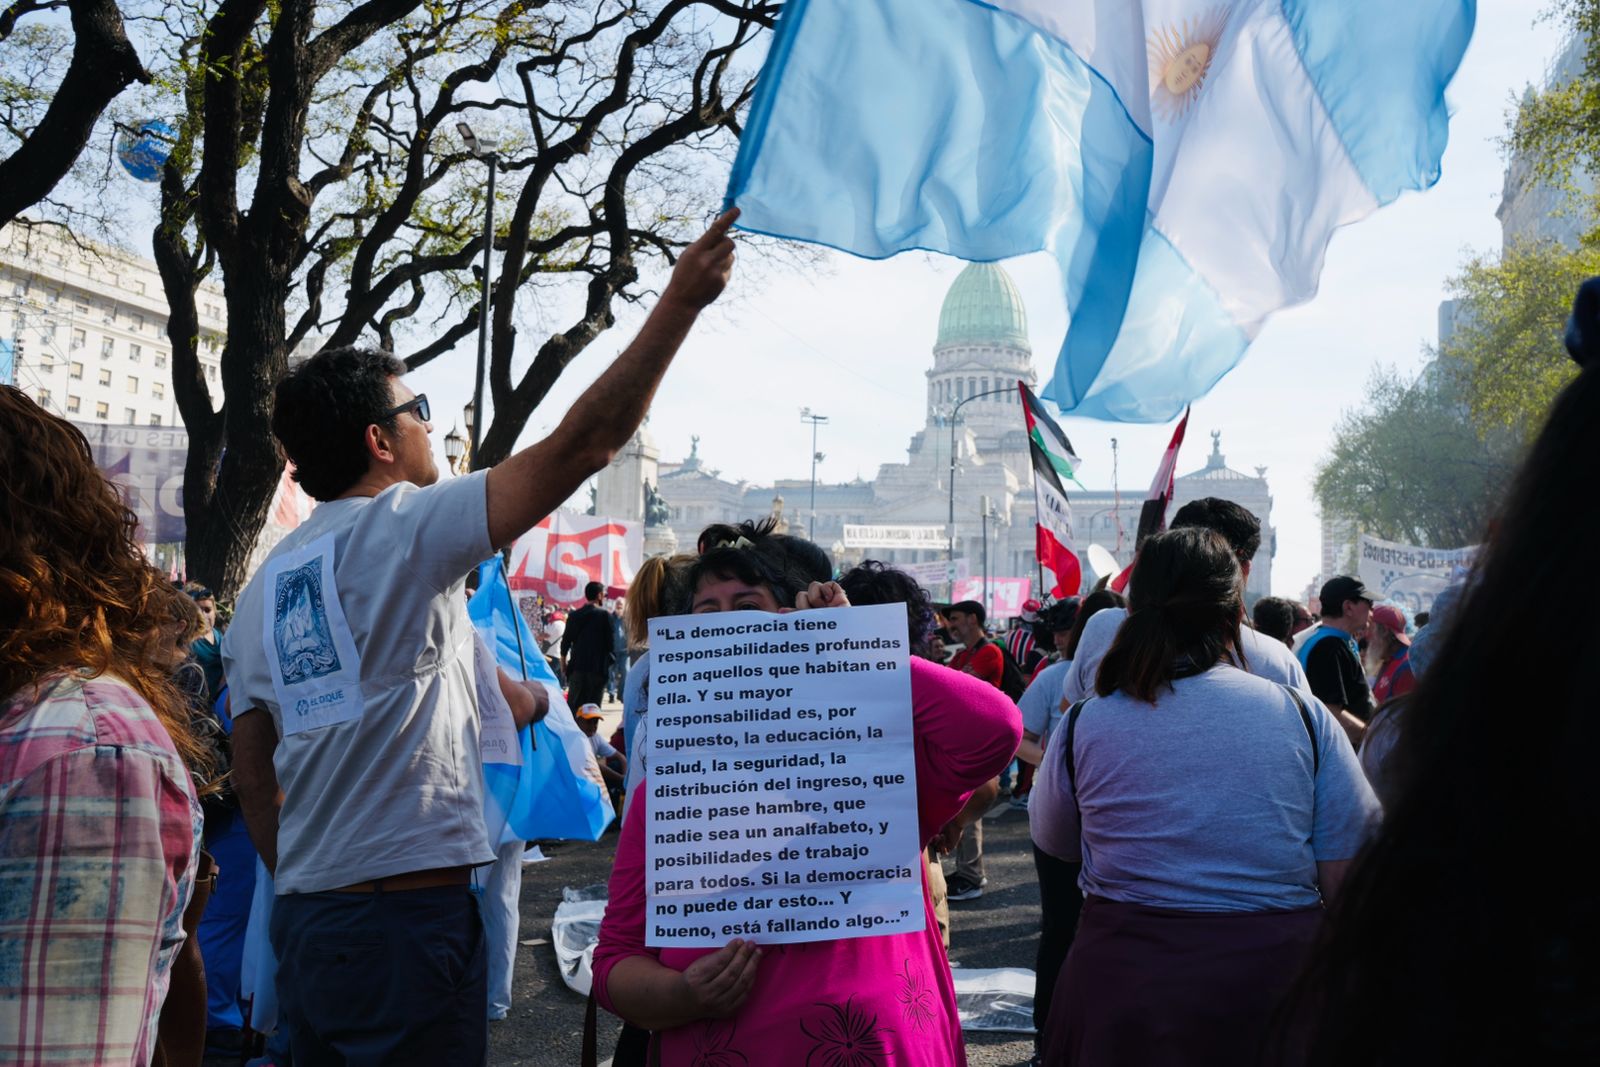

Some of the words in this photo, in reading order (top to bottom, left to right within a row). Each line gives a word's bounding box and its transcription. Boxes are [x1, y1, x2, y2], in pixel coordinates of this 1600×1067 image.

[690, 619, 789, 639] democracia
[793, 618, 838, 632] tiene
[658, 640, 811, 664] responsabilidades
[815, 637, 901, 656] profundas
[657, 672, 688, 685] con
[692, 664, 764, 683] aquellos
[768, 665, 801, 679] que
[805, 660, 871, 675] habitan
[875, 660, 897, 671] en
[656, 691, 692, 706] ella.
[696, 688, 709, 702] Y
[713, 690, 734, 701] su
[738, 687, 794, 702] mayor
[655, 706, 792, 729] responsabilidad
[796, 708, 823, 721] es,
[827, 706, 857, 721] por
[654, 733, 739, 752] supuesto,
[744, 731, 760, 745] la
[765, 726, 862, 744] educación,
[867, 725, 883, 739] la
[654, 759, 707, 776] salud,
[711, 758, 728, 772] la
[733, 752, 825, 773] seguridad,
[830, 751, 847, 765] la
[654, 779, 759, 799] distribución
[763, 777, 791, 792] del
[796, 776, 868, 792] ingreso,
[872, 774, 905, 789] que
[654, 805, 703, 822] nadie
[707, 805, 751, 822] pase
[755, 799, 828, 815] hambre,
[833, 799, 866, 814] que
[654, 828, 704, 845] nadie
[708, 829, 740, 841] sea
[745, 827, 768, 839] un
[772, 820, 874, 838] analfabeto,
[878, 821, 889, 836] y
[654, 848, 773, 871] posibilidades
[777, 846, 801, 861] de
[804, 843, 870, 861] trabajo
[654, 879, 695, 895] para
[699, 874, 756, 889] todos.
[761, 871, 779, 886] Si
[784, 870, 801, 885] la
[806, 864, 912, 884] democracia
[655, 904, 678, 916] no
[683, 897, 738, 918] puede
[743, 896, 774, 911] dar
[778, 893, 835, 909] esto...
[839, 890, 852, 905] Y
[655, 924, 716, 940] bueno,
[721, 919, 762, 936] está
[766, 916, 841, 933] fallando
